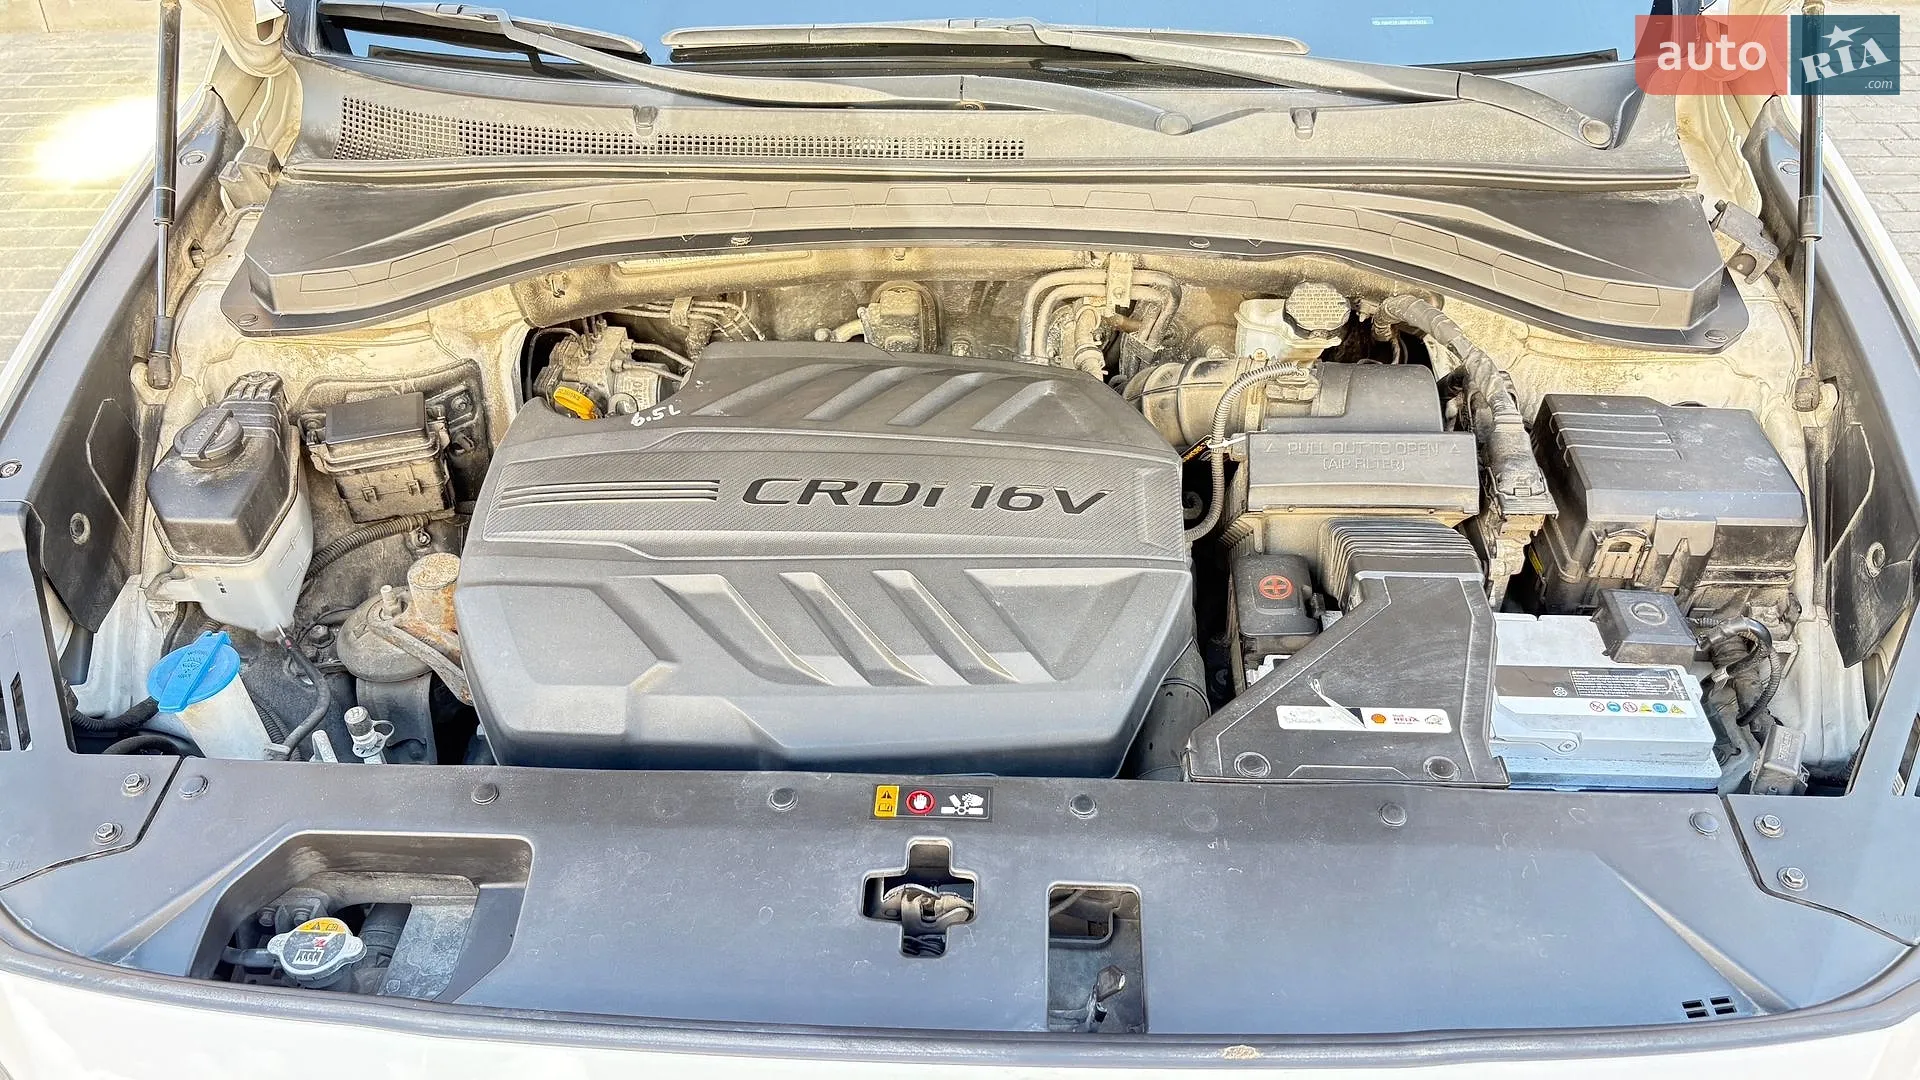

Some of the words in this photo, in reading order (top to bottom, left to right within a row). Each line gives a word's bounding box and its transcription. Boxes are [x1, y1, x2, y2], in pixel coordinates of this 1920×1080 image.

[1288, 441, 1328, 456] PULL
[1333, 441, 1366, 456] OUT
[1368, 441, 1391, 456] TO
[1395, 441, 1440, 456] OPEN
[742, 477, 949, 508] CRDi
[970, 481, 1113, 515] 16V
